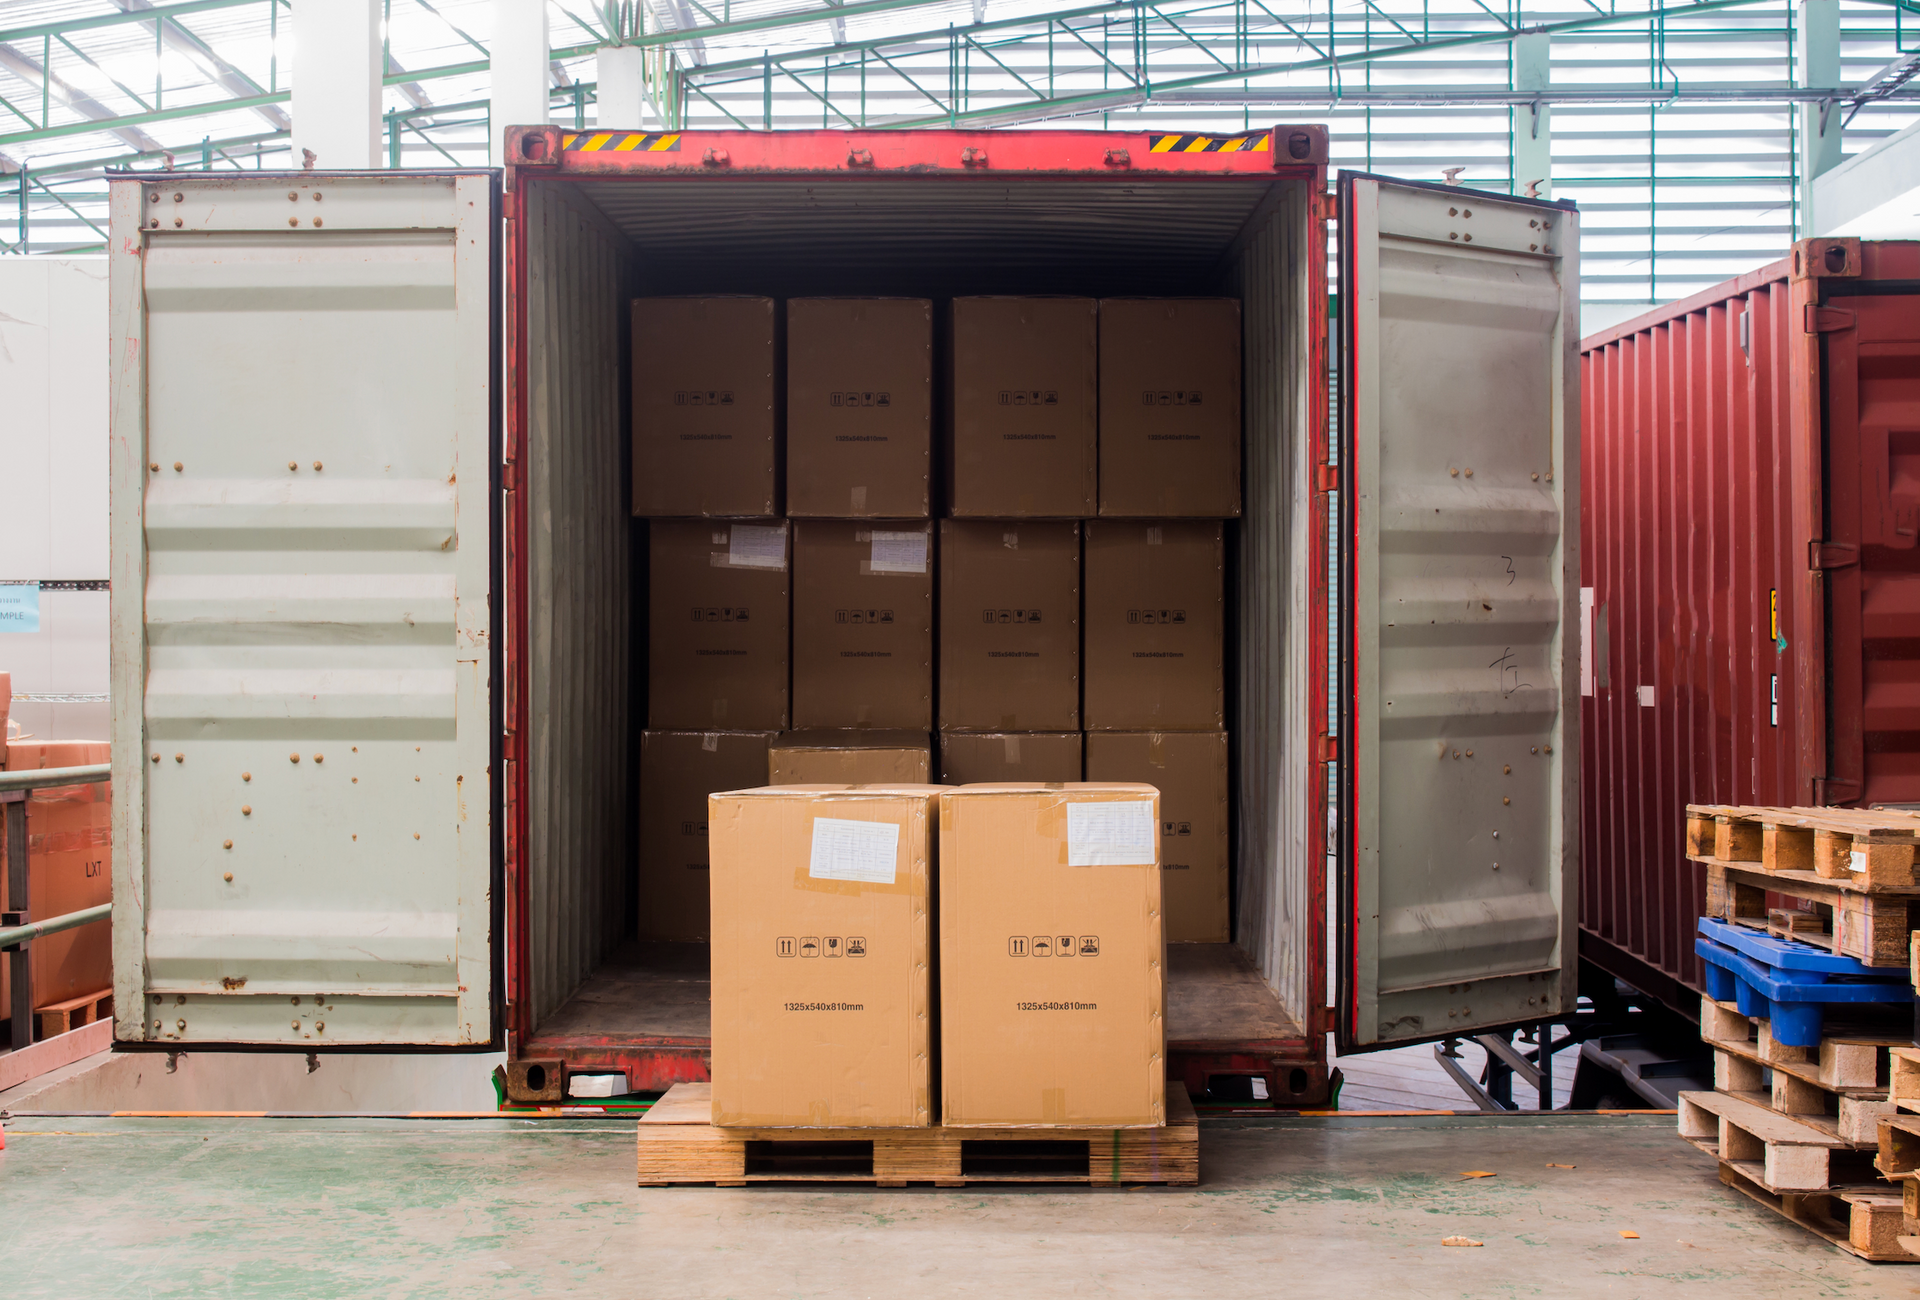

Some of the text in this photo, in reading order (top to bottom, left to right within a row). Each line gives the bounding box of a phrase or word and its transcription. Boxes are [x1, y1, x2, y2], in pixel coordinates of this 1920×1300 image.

[680, 433, 732, 441] 1325x540x810mm
[836, 435, 888, 443] 1325x540x810mm
[1003, 433, 1056, 441] 1325x540x810mm
[1148, 433, 1201, 441] 1325x540x810mm
[0, 611, 24, 621] MPLE
[696, 649, 748, 657] 1325x540x810mm
[840, 650, 892, 658] 1325x540x810mm
[988, 651, 1040, 659] 1325x540x810mm
[1133, 651, 1185, 659] 1325x540x810mm
[85, 860, 102, 878] LXT
[784, 1002, 864, 1012] 1325x540x810mm
[1016, 1001, 1098, 1011] 1325x540x810mm
